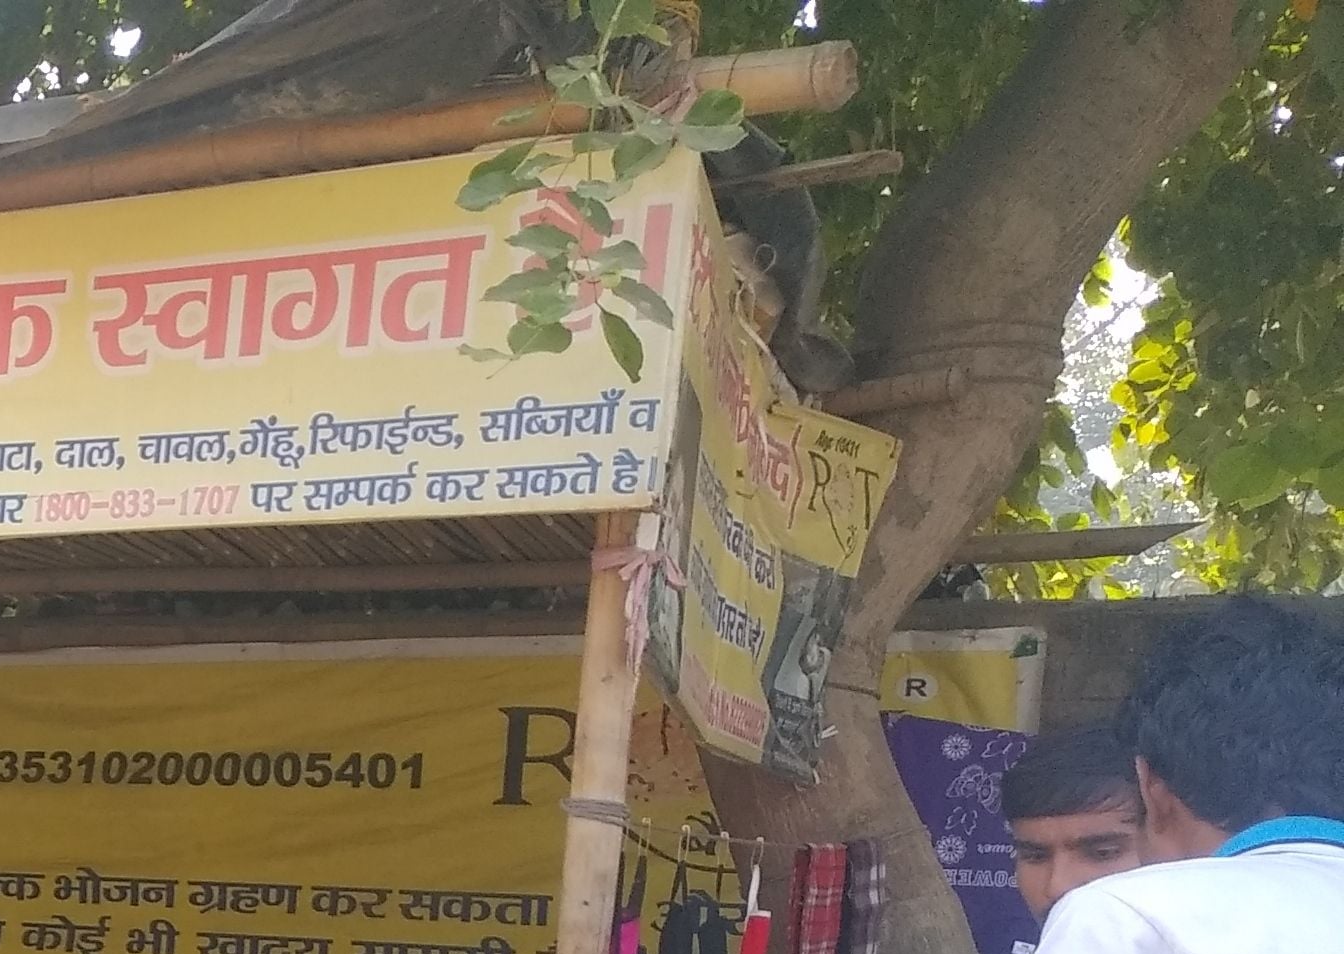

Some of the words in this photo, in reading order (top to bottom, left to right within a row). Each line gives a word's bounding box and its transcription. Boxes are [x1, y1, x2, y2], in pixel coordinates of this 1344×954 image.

[92, 234, 487, 368] स्वागत
[54, 436, 126, 471] दाल,
[628, 398, 660, 433] व
[250, 479, 298, 514] पर
[425, 467, 489, 505] कर
[495, 452, 604, 501] सकते
[904, 677, 928, 698] R
[53, 866, 178, 909] भोजन
[187, 878, 302, 918] ग्रहण
[310, 884, 393, 919] कर
